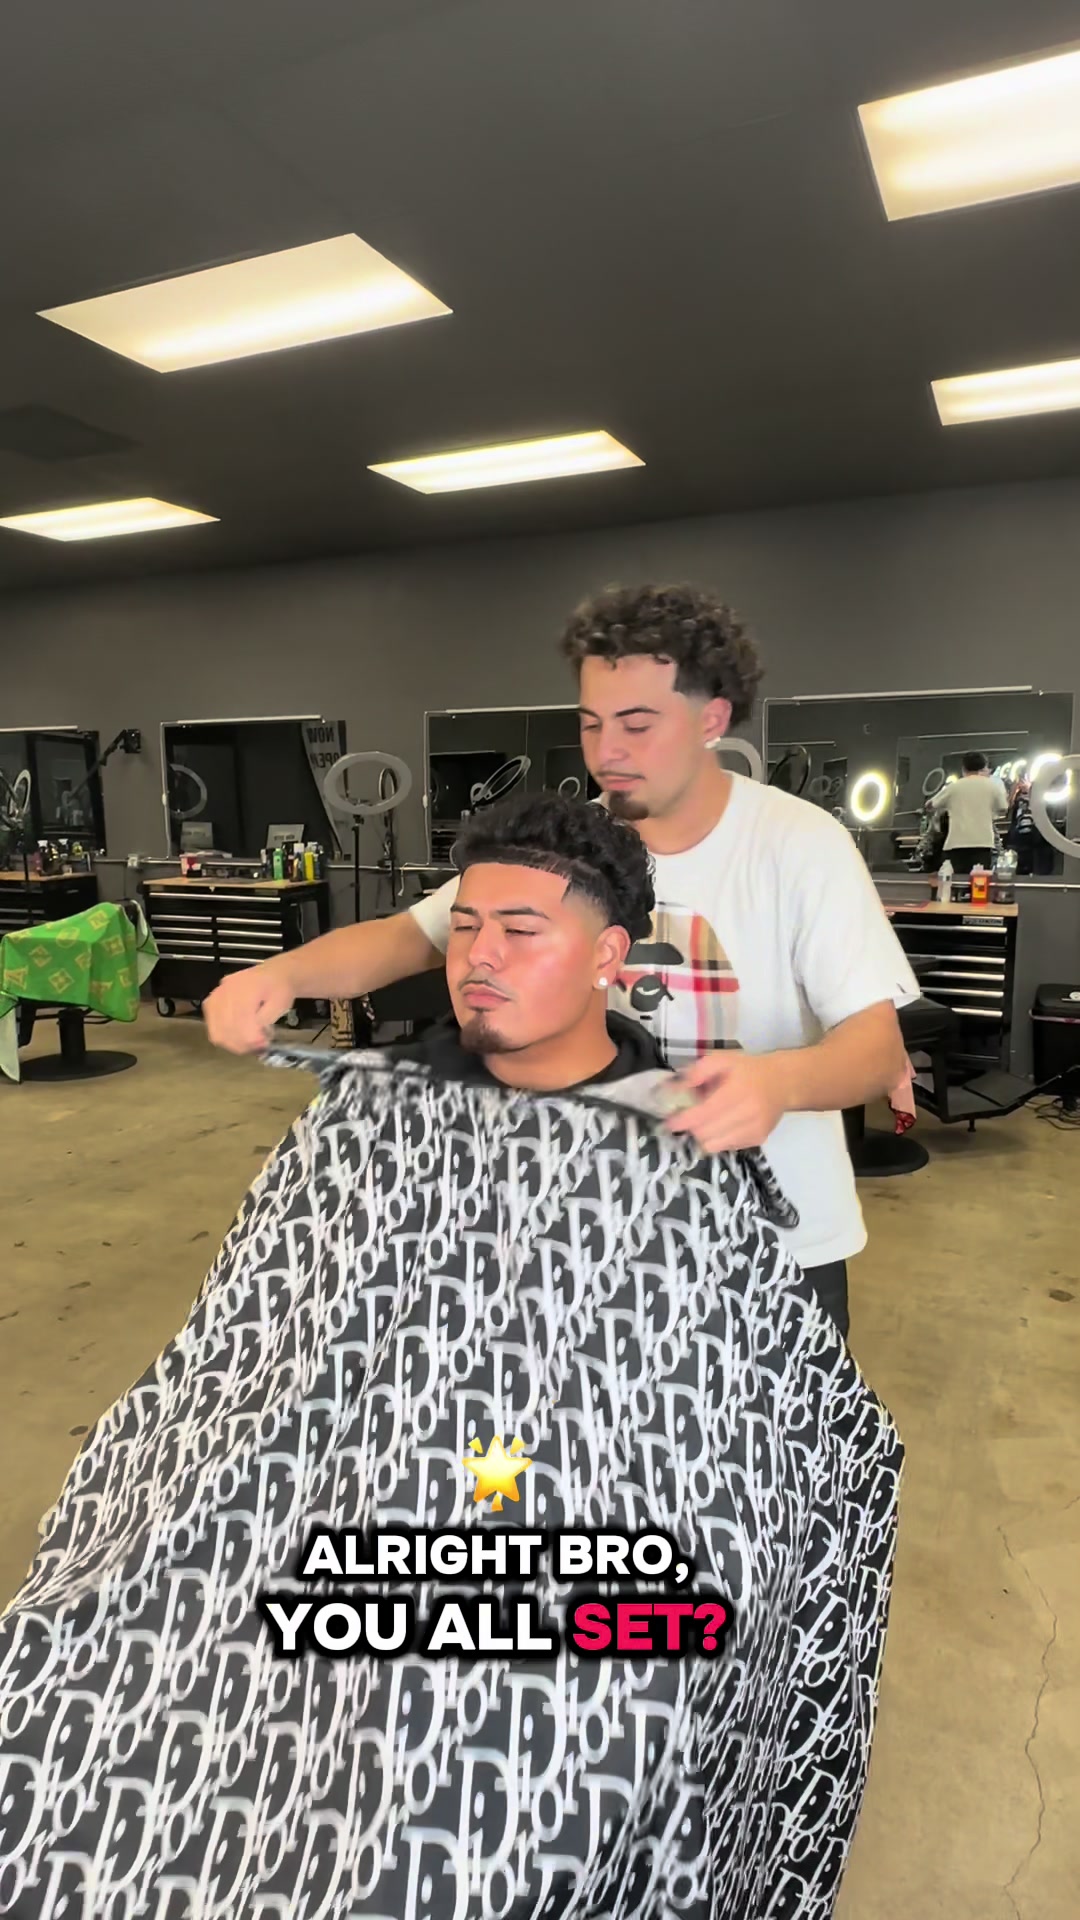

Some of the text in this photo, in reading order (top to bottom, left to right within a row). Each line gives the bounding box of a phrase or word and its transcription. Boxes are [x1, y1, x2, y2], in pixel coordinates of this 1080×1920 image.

[533, 1238, 598, 1347] Dior
[561, 1197, 630, 1302] Dior
[385, 1326, 455, 1441] Dior
[419, 1275, 490, 1382] Dior
[627, 1261, 693, 1376] Dior
[353, 1384, 417, 1501] Dior
[145, 1568, 222, 1700] Dior
[196, 1510, 271, 1633] Dior
[25, 1690, 113, 1836] Dior
[84, 1629, 172, 1764] Dior
[192, 1643, 269, 1787] Dior
[373, 1653, 463, 1815] Dior
[494, 1673, 586, 1842] Dior
[136, 1711, 220, 1862] Dior
[237, 1724, 312, 1881] Dior
[328, 1727, 410, 1900] Dior
[442, 1746, 539, 1920] Dior
